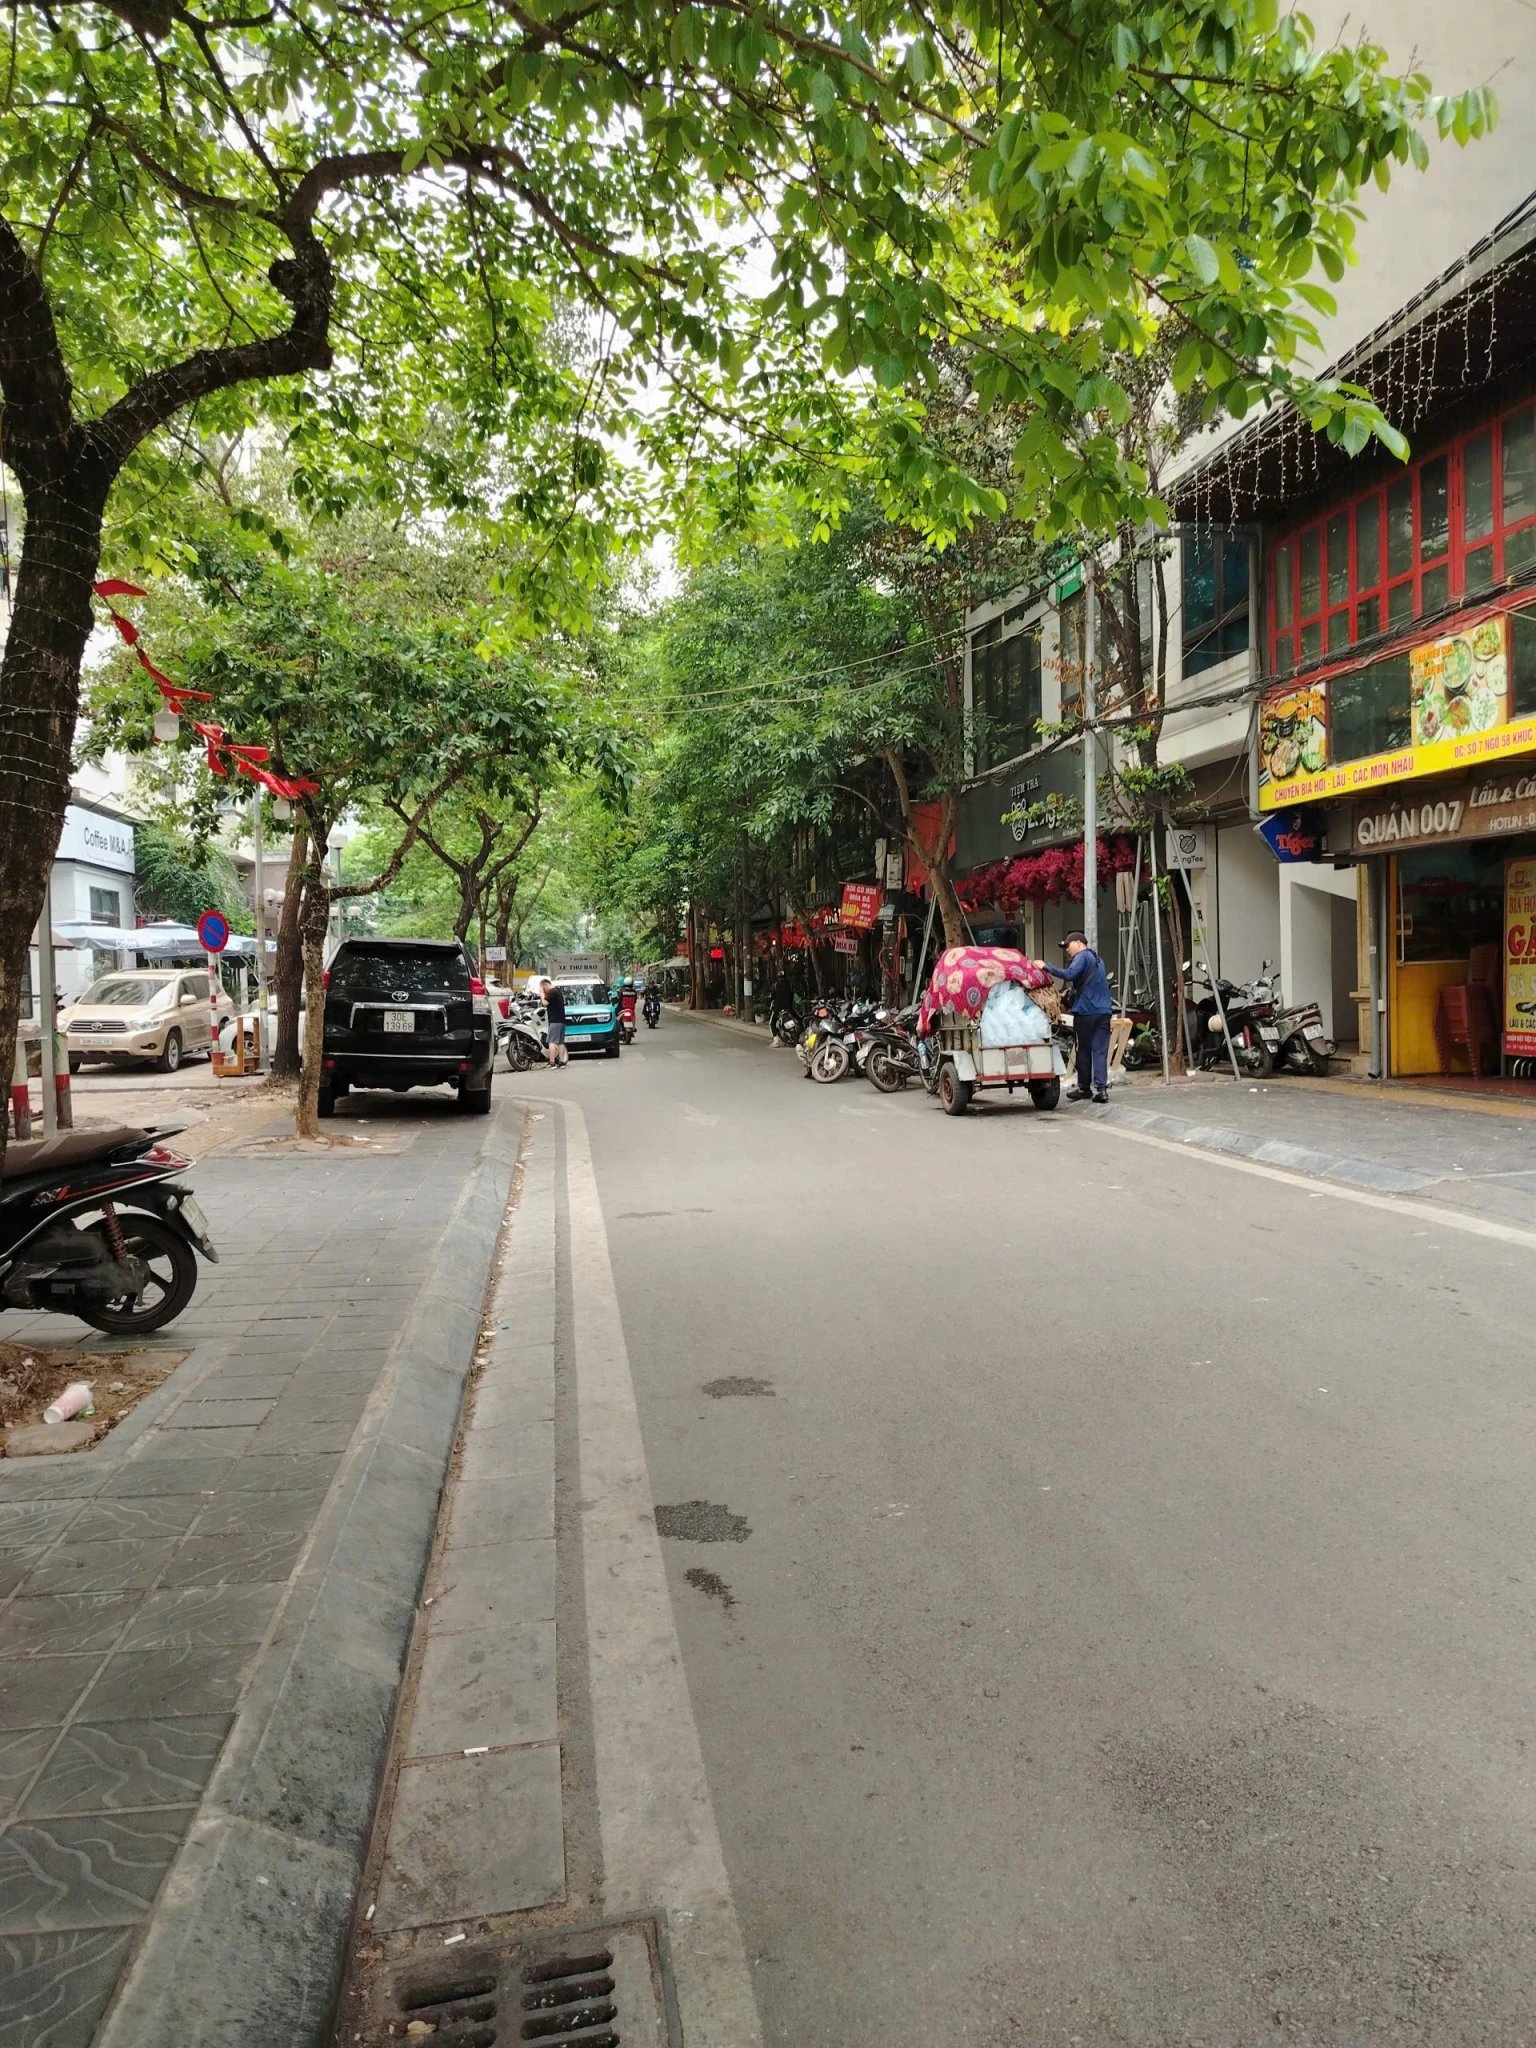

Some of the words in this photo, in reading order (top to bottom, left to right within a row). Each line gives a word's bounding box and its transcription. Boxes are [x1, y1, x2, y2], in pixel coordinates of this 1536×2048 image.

[1479, 741, 1483, 753] 7
[1502, 734, 1511, 748] 58
[1301, 783, 1312, 797] BIA
[1353, 766, 1368, 784] CÁC
[1357, 801, 1419, 846] QUÁN
[1420, 800, 1464, 835] 007
[84, 826, 108, 851] Coffee
[1275, 832, 1316, 856] Tiger
[1173, 855, 1204, 864] ZngTee
[391, 1012, 407, 1022] 30E
